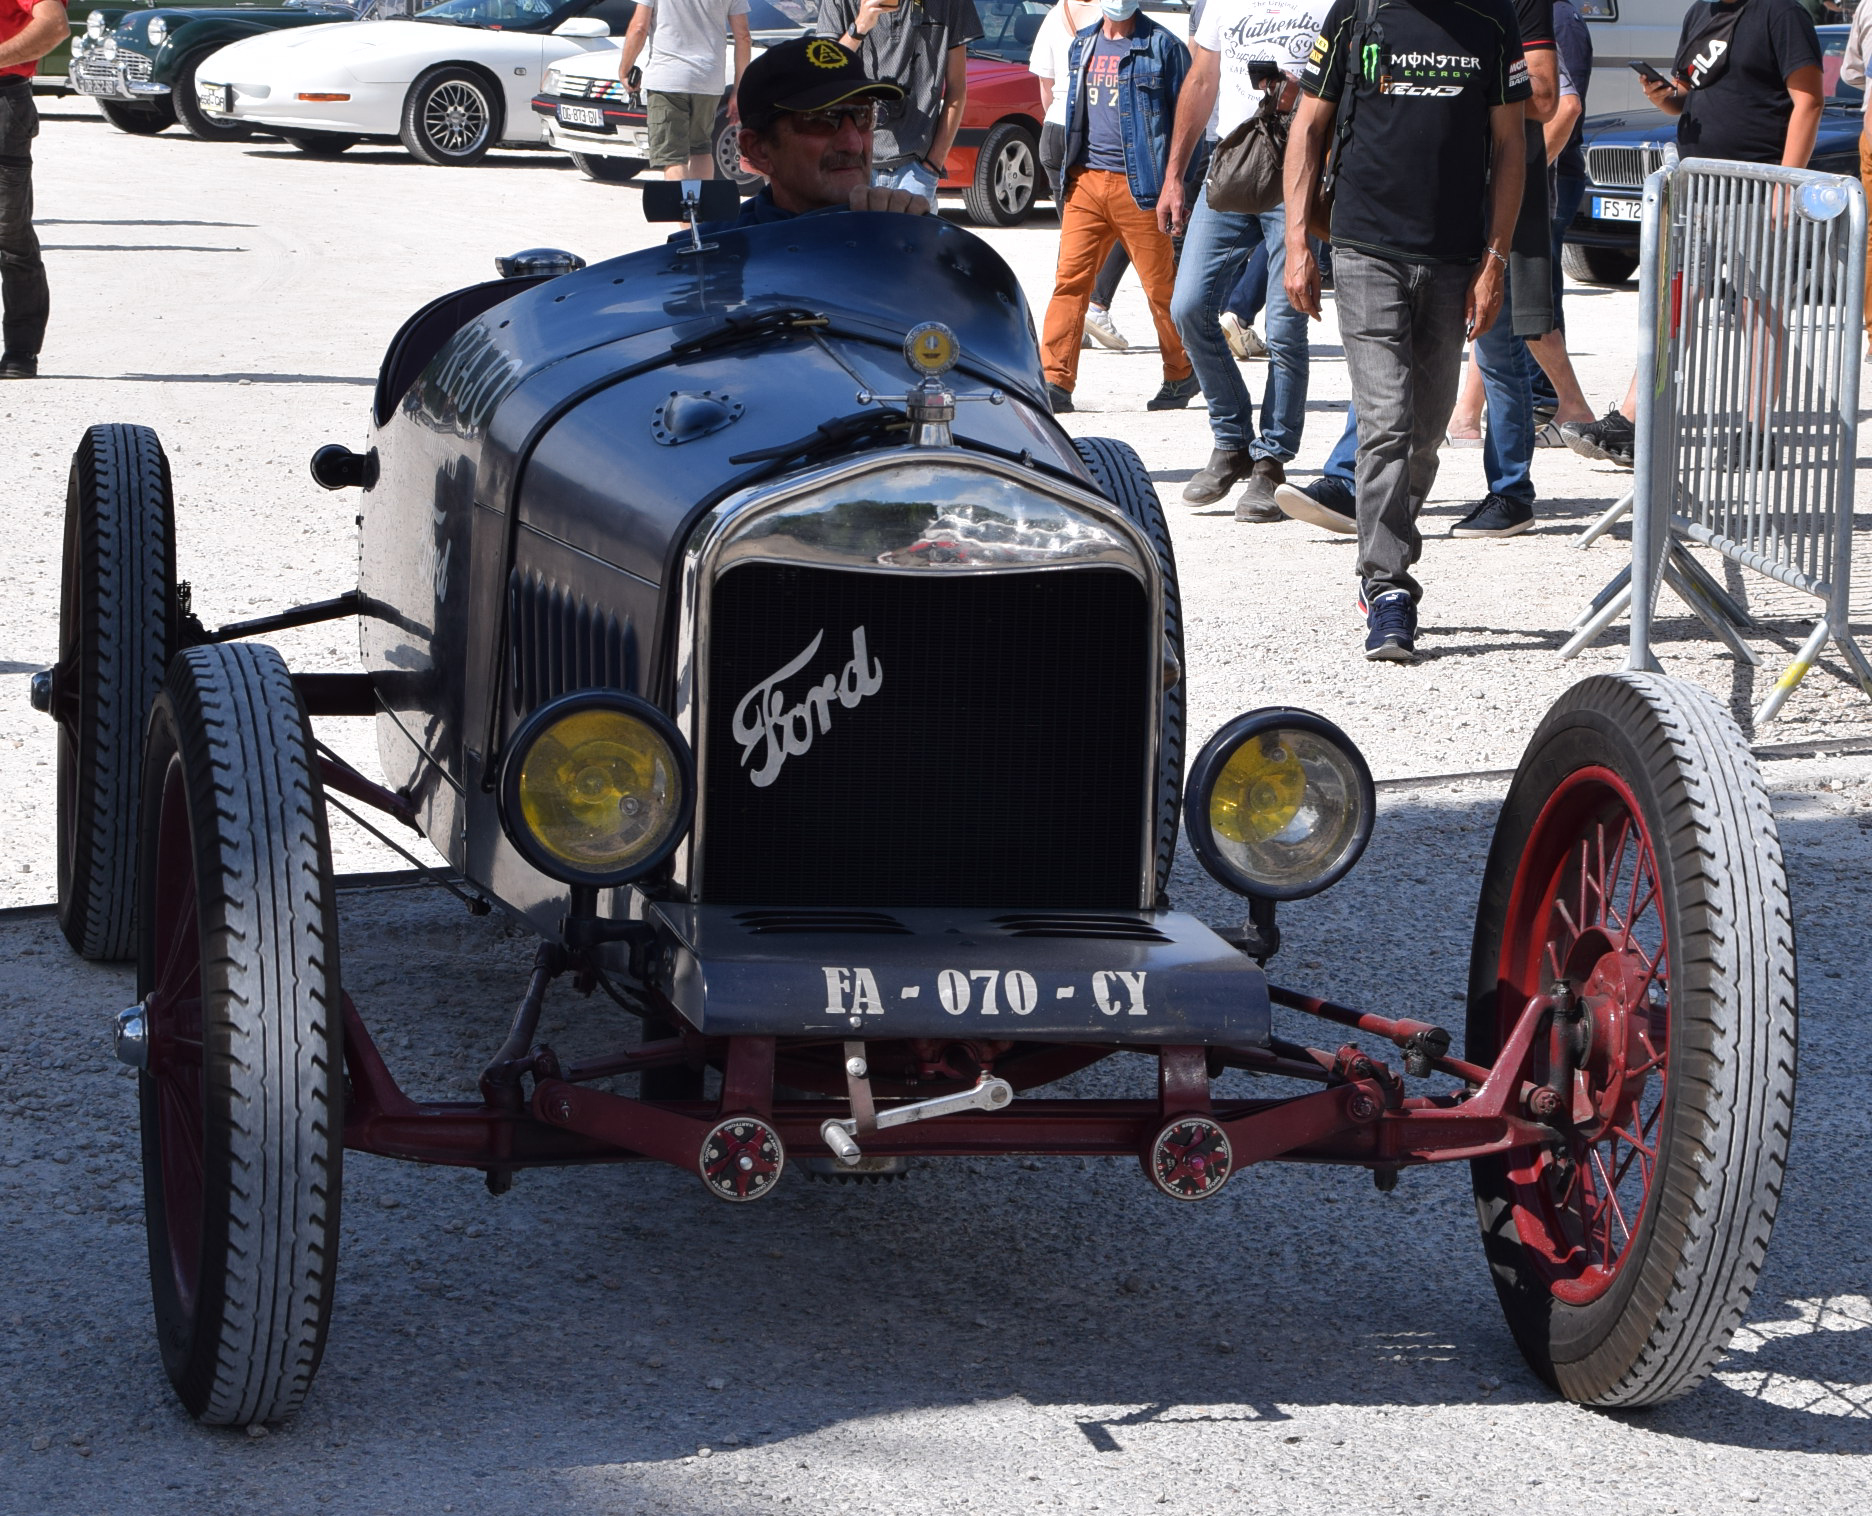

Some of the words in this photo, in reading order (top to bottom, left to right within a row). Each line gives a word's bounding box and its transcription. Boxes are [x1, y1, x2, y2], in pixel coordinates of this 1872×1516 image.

[1224, 11, 1321, 46] Authentic
[1292, 39, 1313, 54] 89
[1404, 70, 1471, 78] ENERGY
[1687, 39, 1728, 88] FILA
[732, 624, 883, 788] Ford
[821, 966, 885, 1015] FA
[937, 969, 1038, 1016] 070
[1092, 971, 1148, 1016] CY
